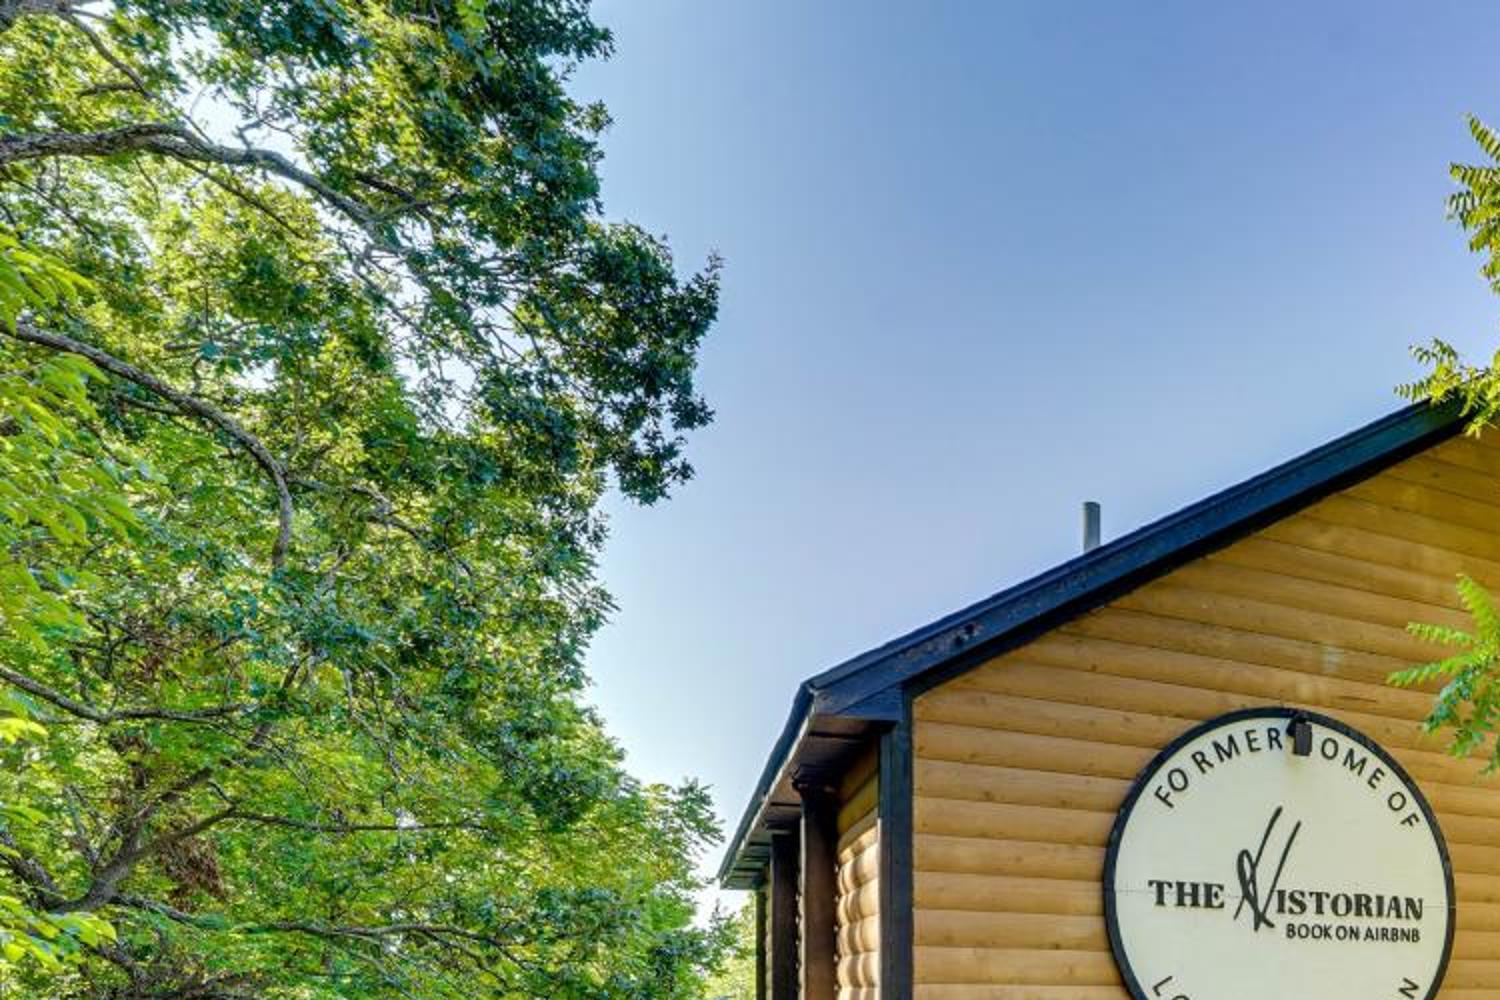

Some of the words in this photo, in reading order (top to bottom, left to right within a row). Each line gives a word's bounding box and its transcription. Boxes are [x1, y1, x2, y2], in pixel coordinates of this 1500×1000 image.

[1154, 727, 1283, 809] FORMER
[1299, 733, 1385, 789] OME
[1387, 791, 1420, 829] OF
[1148, 879, 1225, 909] THE
[1286, 923, 1332, 940] BOOK
[1335, 925, 1360, 941] ON
[1363, 926, 1421, 943] AIRBNB
